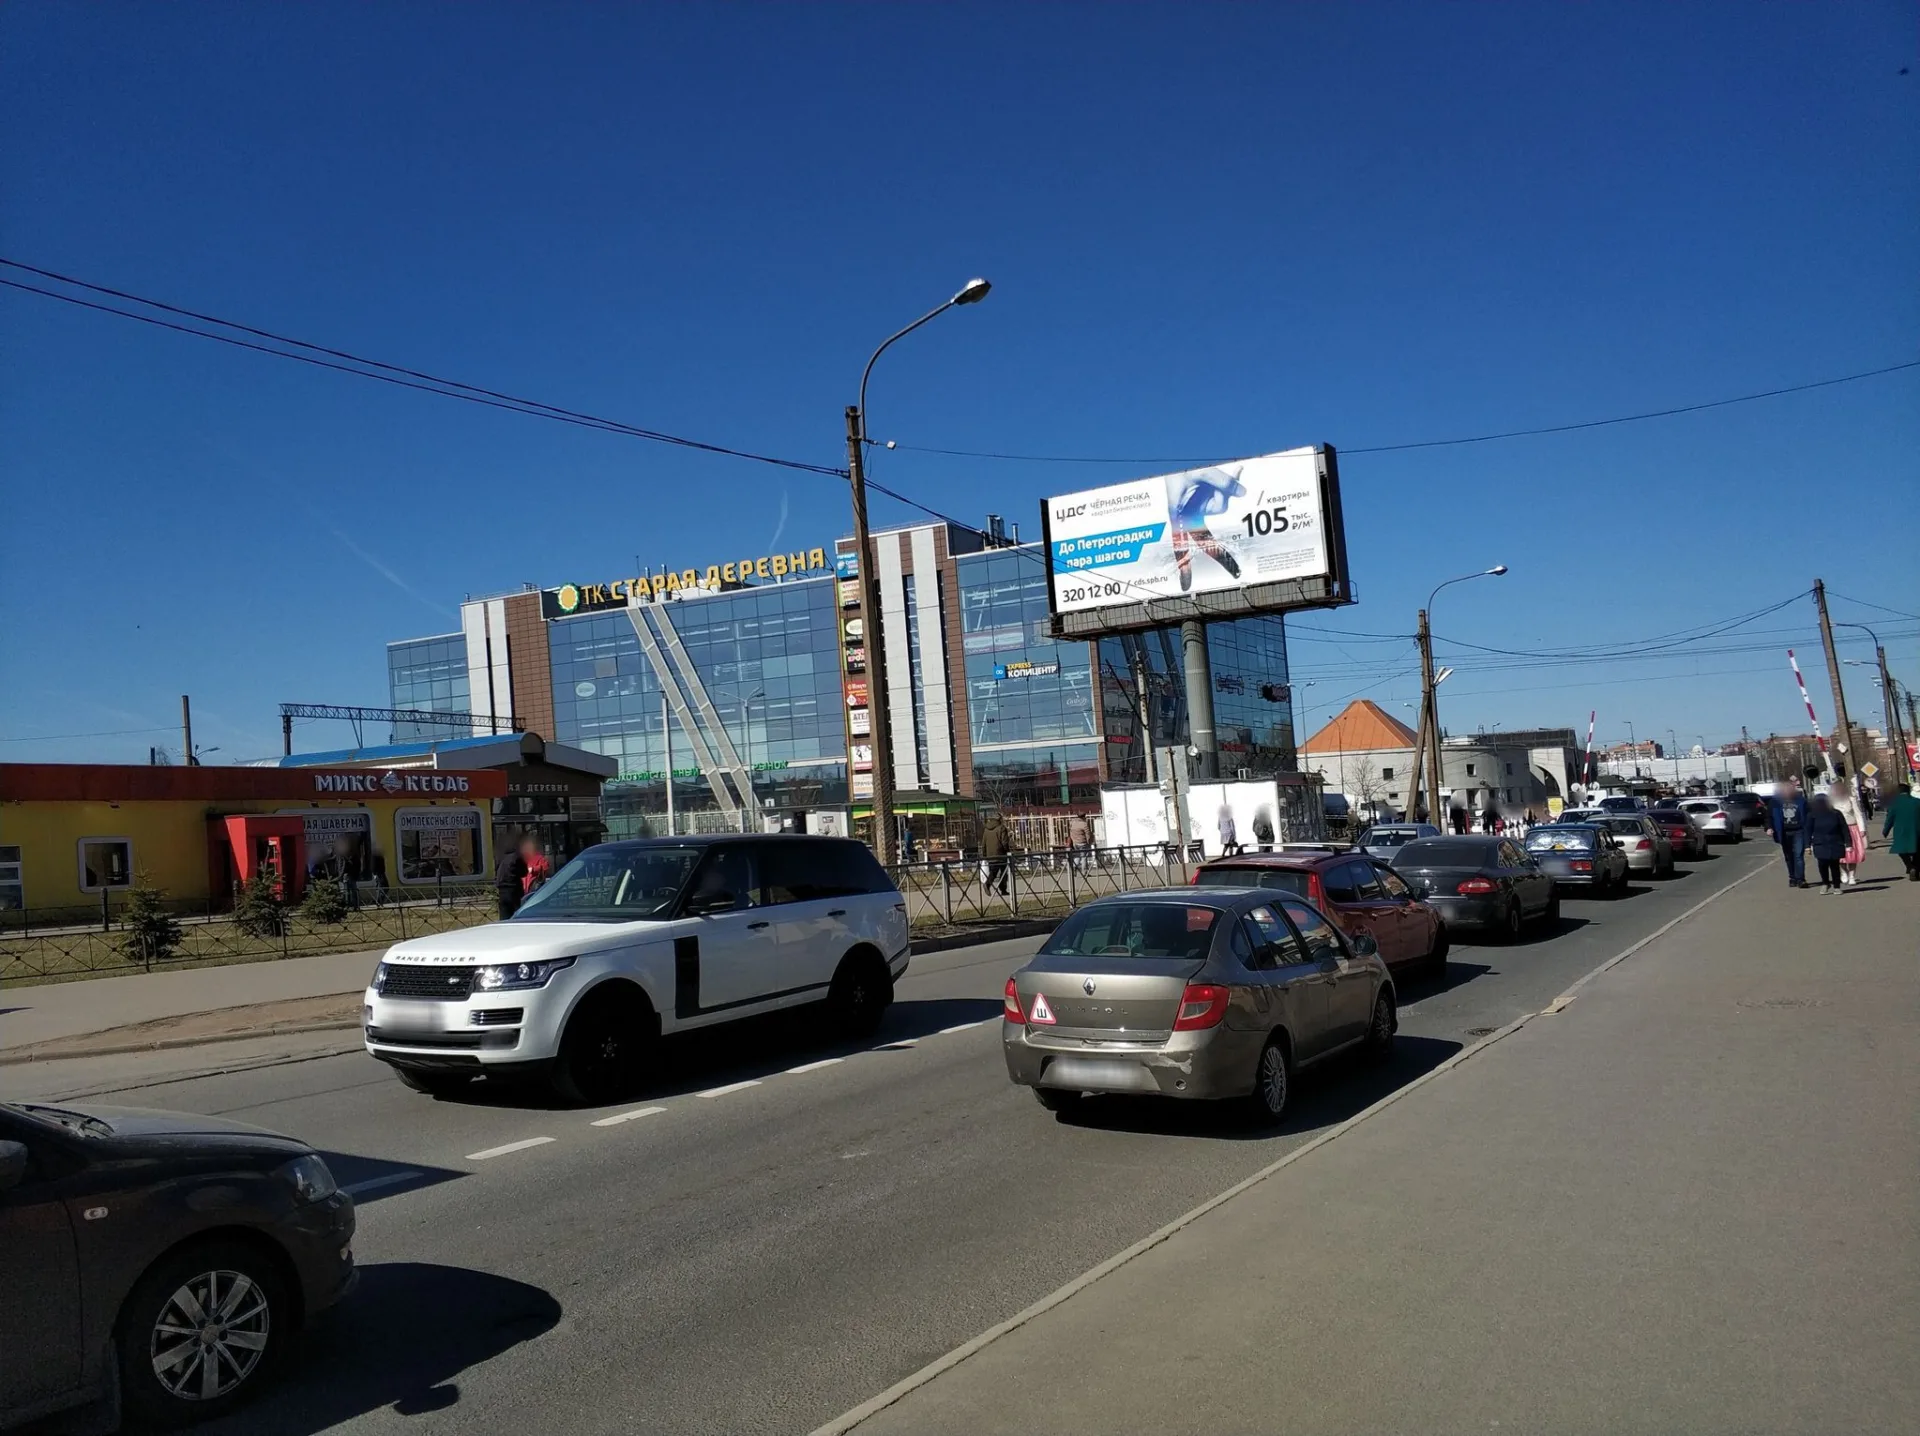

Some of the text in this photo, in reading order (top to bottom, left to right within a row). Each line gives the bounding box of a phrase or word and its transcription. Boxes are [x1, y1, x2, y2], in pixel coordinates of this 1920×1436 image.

[1124, 492, 1150, 503] РЕЧКА
[1266, 491, 1310, 504] квартиры
[1056, 504, 1086, 522] ЦДС
[1241, 506, 1289, 538] 105
[1058, 529, 1153, 557] До Петроградки
[1066, 550, 1131, 569] пара шагов
[581, 583, 606, 605] ТК
[611, 569, 698, 599] СТАРАЯ
[706, 547, 826, 589] ДЕРЕВНЯ
[1062, 575, 1168, 603] 320 12 00 cds.spb.ru
[1006, 662, 1032, 670] EXPRESS
[1007, 665, 1057, 678] КОПИЦЕНТР
[751, 760, 788, 771] РЫНОК
[314, 774, 469, 792] МИКС КЕБАБ
[527, 783, 569, 793] ДЕРЕВНЯ
[320, 818, 364, 830] ШАВЕРМА
[401, 815, 475, 827] ОМПЛЕКСНЫЕ ОБЕДЫ
[1036, 1007, 1047, 1019] Ш
